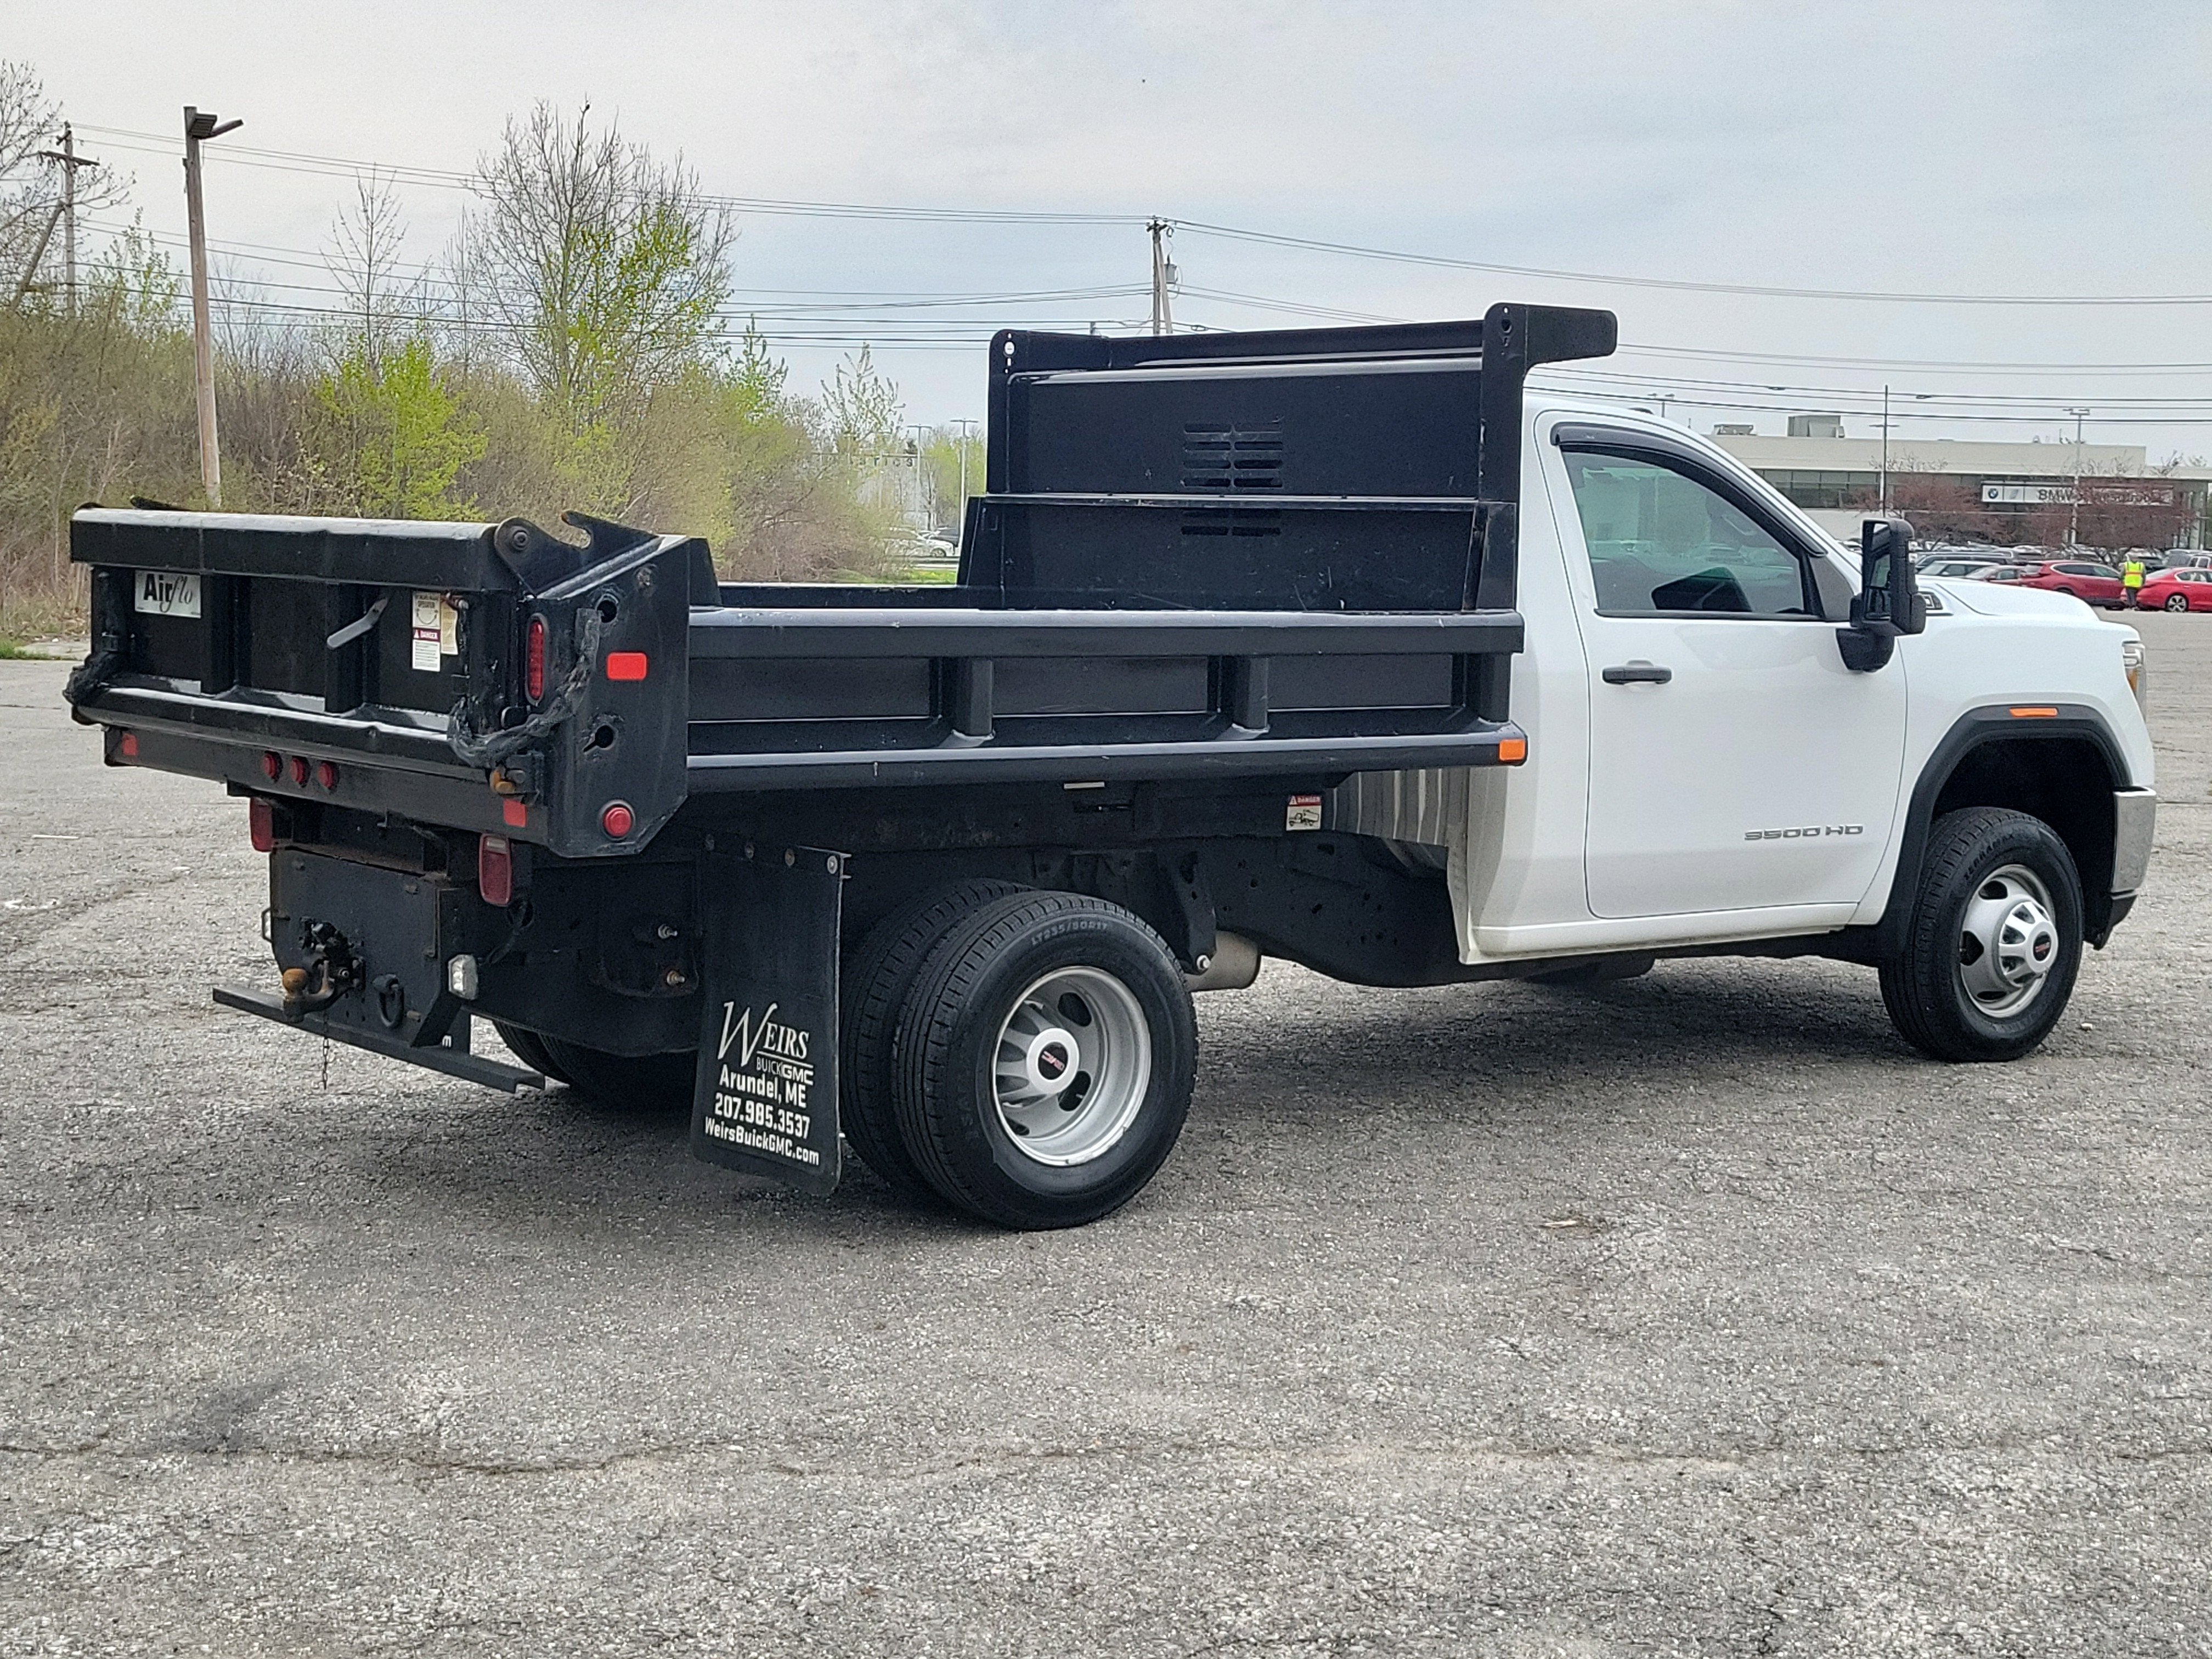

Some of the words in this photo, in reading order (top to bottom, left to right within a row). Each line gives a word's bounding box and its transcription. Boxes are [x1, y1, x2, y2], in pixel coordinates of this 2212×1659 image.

[2038, 489, 2073, 501] BMW
[143, 573, 193, 613] Airflo
[1745, 826, 1821, 840] 3500
[1825, 824, 1864, 836] HD
[719, 1064, 782, 1105] Arundel,
[786, 1084, 806, 1108] ME
[757, 1056, 782, 1075] BUICK
[782, 1064, 814, 1086] GMC
[714, 1092, 811, 1139] 207.985.3537
[705, 1116, 820, 1166] WeirsBuickGMC.com
